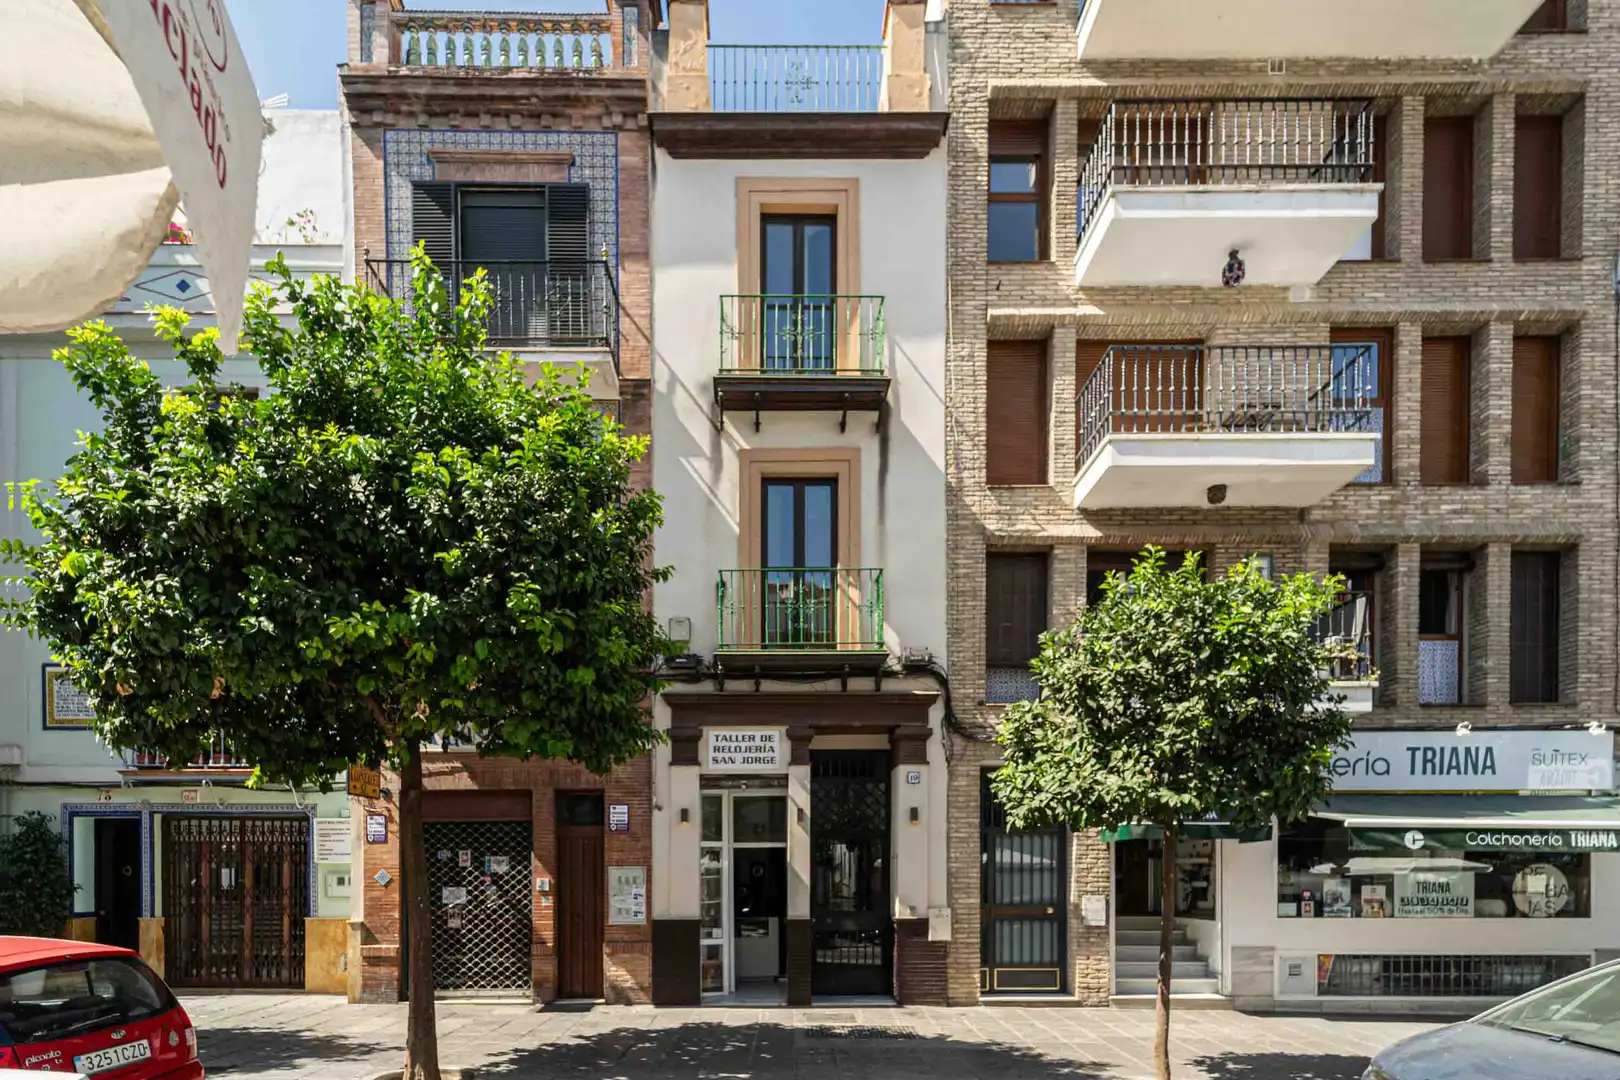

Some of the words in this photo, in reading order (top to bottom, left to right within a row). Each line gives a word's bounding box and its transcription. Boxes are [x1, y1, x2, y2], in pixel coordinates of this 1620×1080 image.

[714, 734, 756, 742] TALLER
[760, 734, 775, 742] DE
[713, 743, 775, 753] RELOJERÍA
[712, 756, 736, 764] SAN
[740, 756, 776, 764] JORGE
[1328, 751, 1390, 776] ería
[1406, 746, 1497, 776] TRIANA
[1465, 831, 1563, 846] Colchonería
[1569, 830, 1618, 848] TRIANA
[1416, 881, 1451, 894] TRIANA
[86, 1043, 147, 1070] 3251CZD
